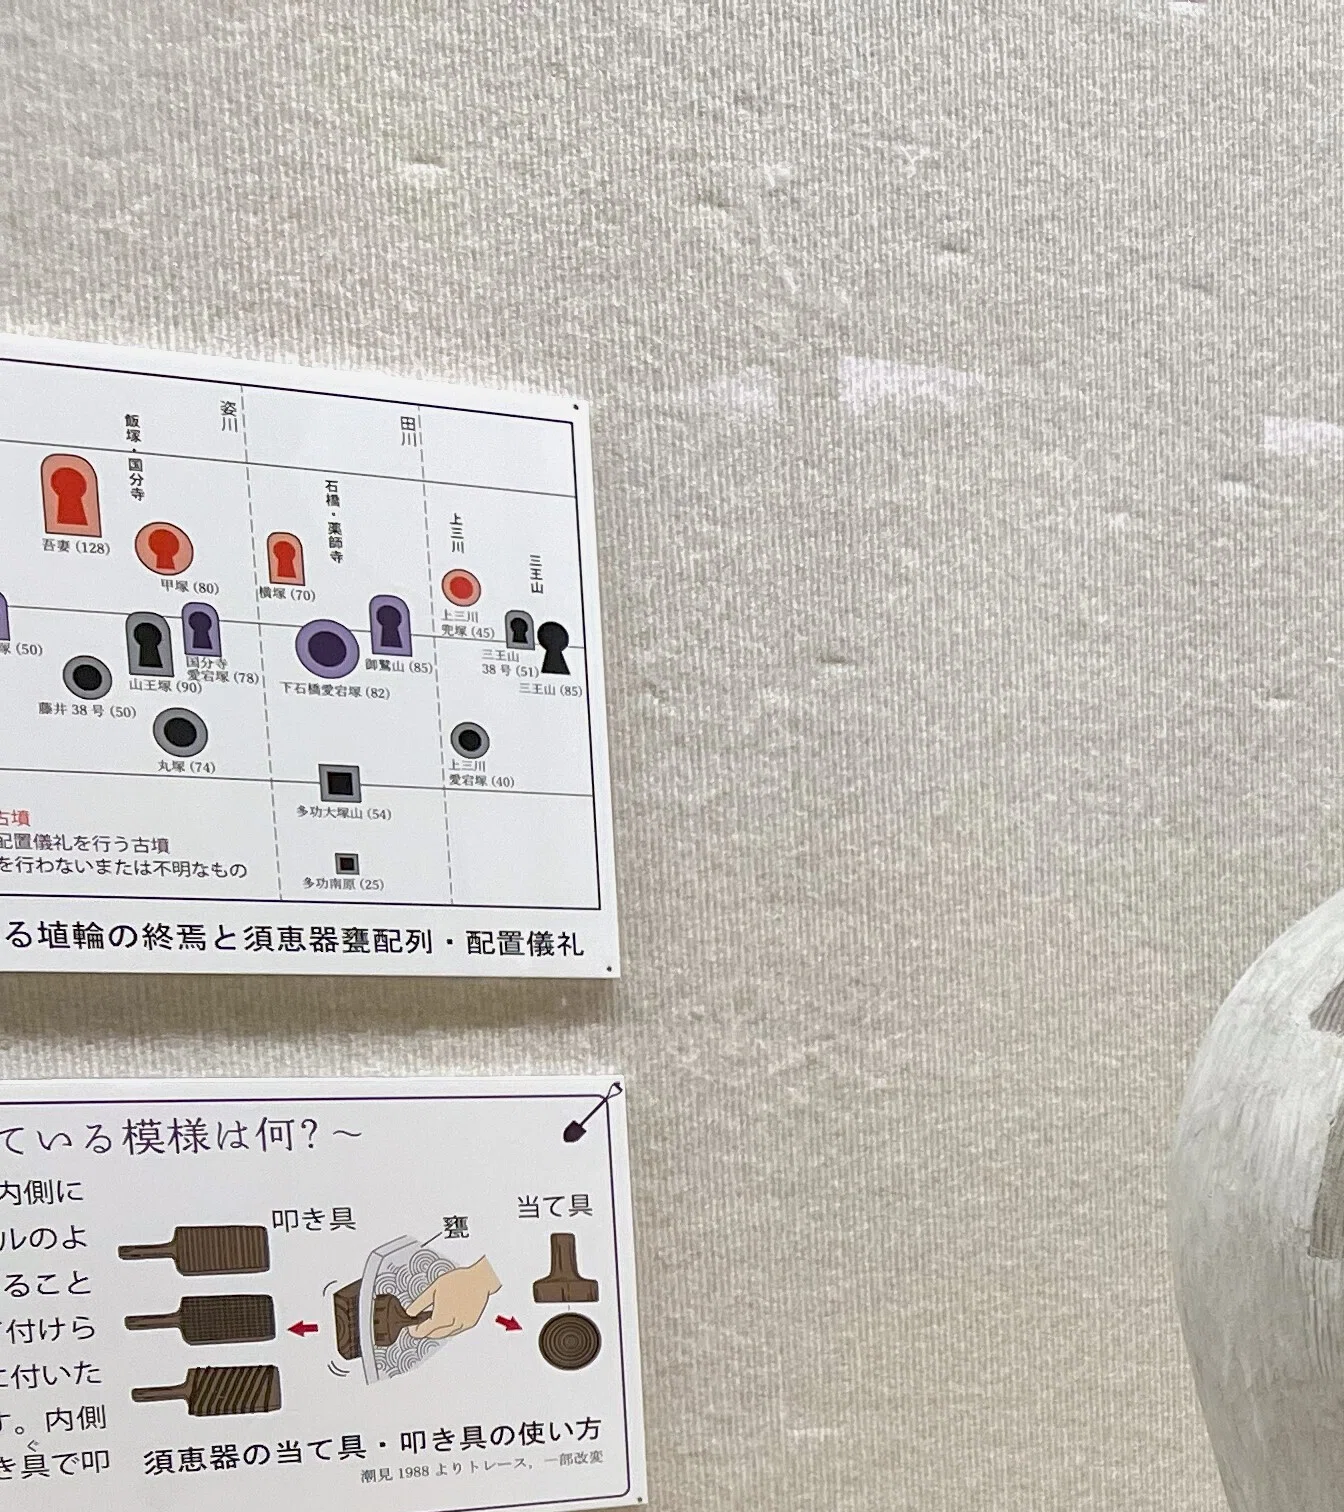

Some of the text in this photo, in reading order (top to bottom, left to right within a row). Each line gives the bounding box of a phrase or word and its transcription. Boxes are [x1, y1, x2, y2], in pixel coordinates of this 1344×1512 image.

[220, 401, 238, 433] 姿川
[401, 416, 417, 447] 田川
[325, 479, 344, 564] 石橋・薬師寺
[449, 513, 465, 554] 上三川
[75, 541, 110, 555] (128)
[529, 554, 544, 595] 三王山
[160, 579, 220, 595] 甲塚 (80)
[290, 587, 316, 601] (70)
[441, 610, 479, 623] 上三川
[471, 625, 495, 639] (45)
[16, 643, 43, 656] (50)
[482, 650, 520, 662] 三王山
[409, 660, 434, 675] (85)
[233, 671, 260, 685] (78)
[177, 681, 202, 694] (90)
[365, 683, 390, 698] (82)
[560, 684, 583, 697] (85)
[110, 705, 137, 718] (50)
[190, 761, 216, 775] (74)
[448, 759, 485, 771] 上三川
[367, 809, 391, 822] (54)
[360, 878, 384, 891] (25)
[5, 920, 585, 957] る埴輪の終焉と須恵器甕配列・配置儀礼
[517, 1193, 593, 1219] 当て具
[272, 1207, 356, 1232] 叩き具
[444, 1214, 470, 1239] 甕
[4, 1270, 91, 1298] ること
[144, 1416, 602, 1476] 須恵器の当て具・叩き具の使い方
[398, 1465, 429, 1479] 1988
